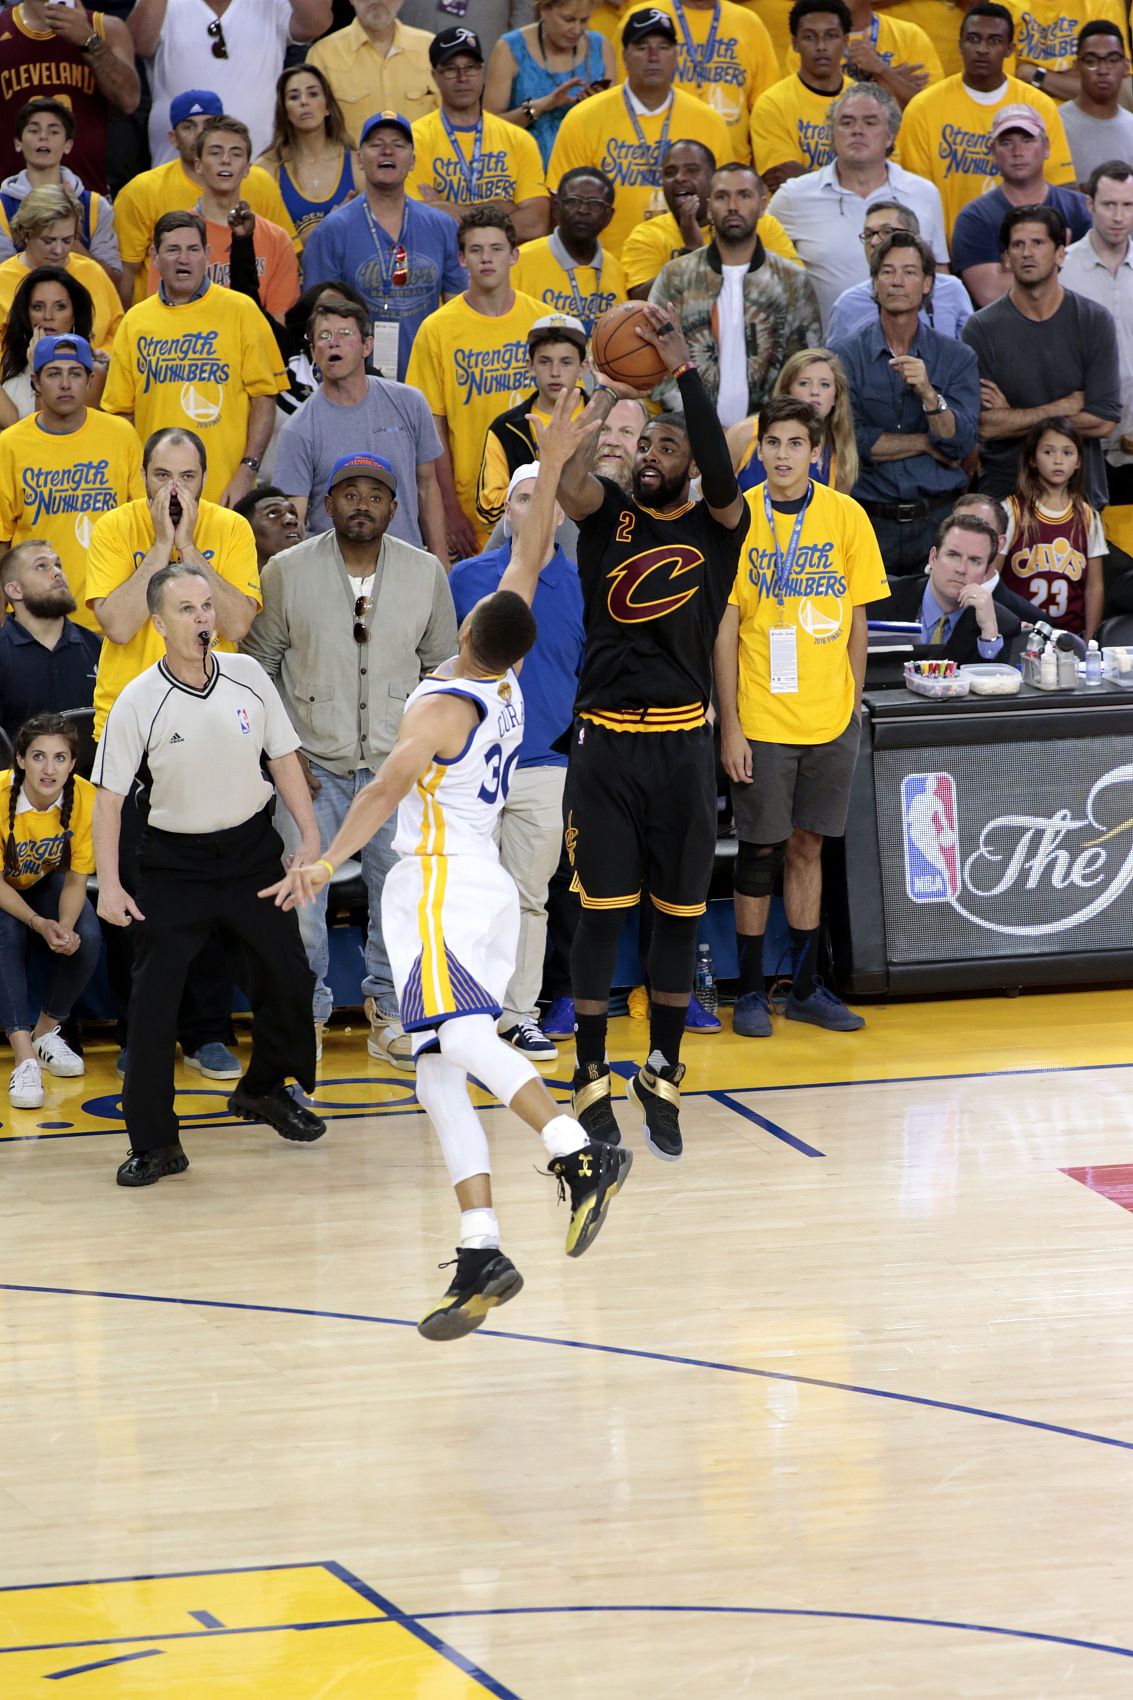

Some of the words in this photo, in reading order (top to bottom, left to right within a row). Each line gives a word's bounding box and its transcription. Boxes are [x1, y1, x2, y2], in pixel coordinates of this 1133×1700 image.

[1, 62, 96, 100] CLEVELAND
[137, 330, 221, 374] Strength
[143, 357, 230, 393] NUMBERS
[22, 459, 110, 506] Strength
[616, 511, 635, 542] 2
[1011, 537, 1086, 581] CAVS
[606, 544, 705, 623] C
[1029, 577, 1068, 618] 23
[498, 703, 524, 738] CUR
[964, 809, 1108, 897] The
